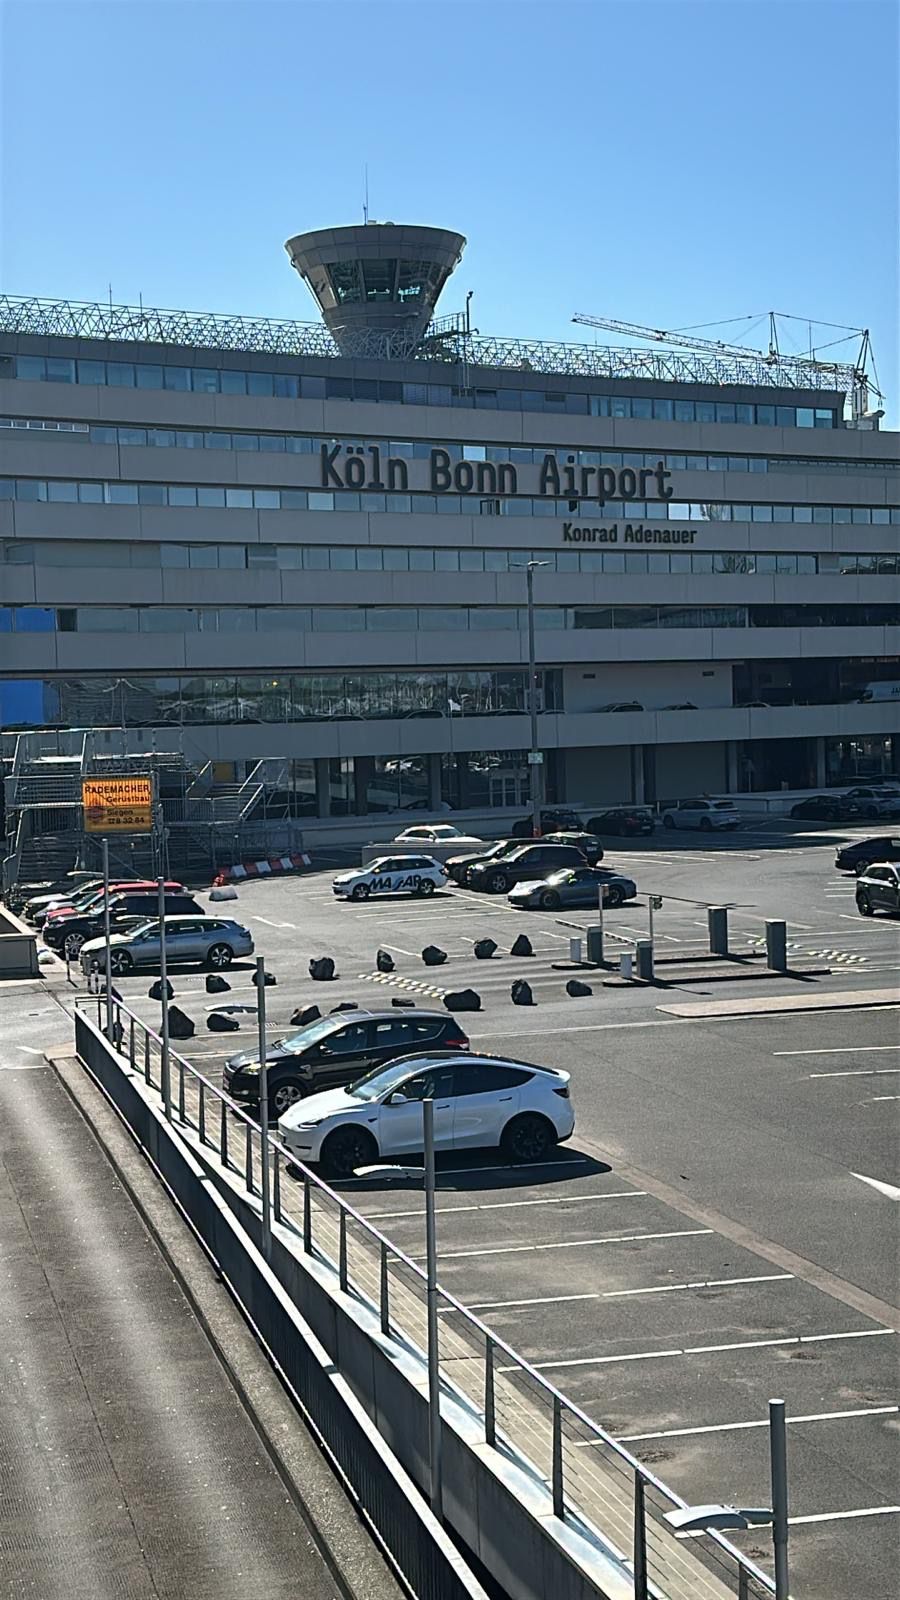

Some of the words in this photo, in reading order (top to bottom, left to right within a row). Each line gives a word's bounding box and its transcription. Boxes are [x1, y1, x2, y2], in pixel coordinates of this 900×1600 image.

[320, 443, 409, 490] Köln
[430, 448, 518, 494] Bonn
[540, 453, 674, 508] Airport
[562, 522, 618, 543] Konrad
[624, 524, 698, 544] Adenauer
[84, 785, 149, 794] RADEMACHER
